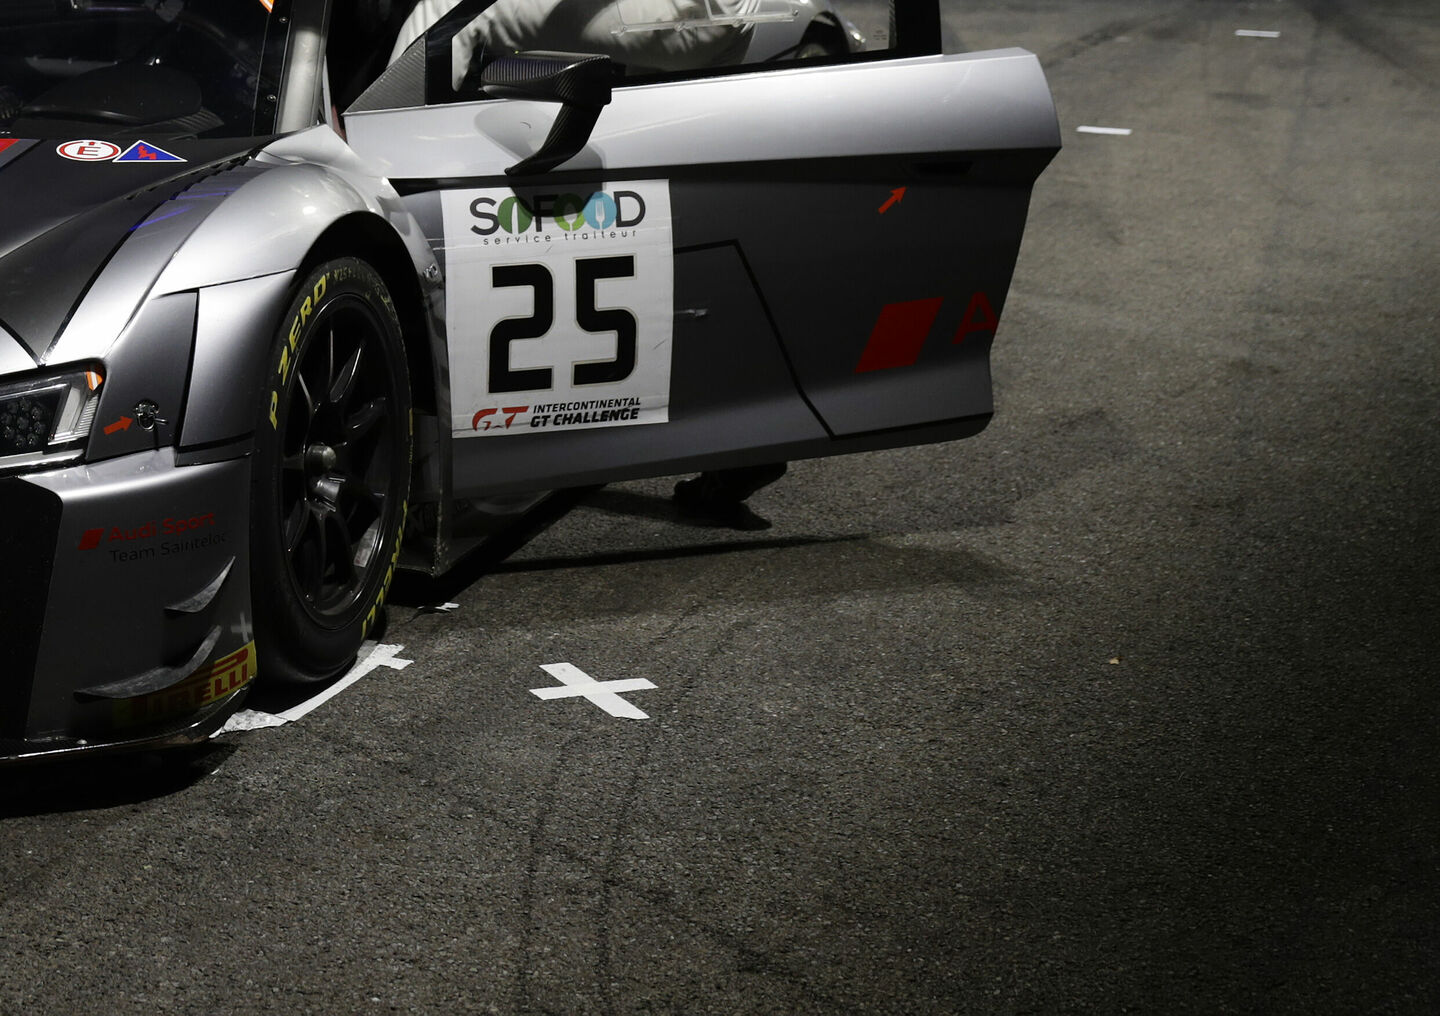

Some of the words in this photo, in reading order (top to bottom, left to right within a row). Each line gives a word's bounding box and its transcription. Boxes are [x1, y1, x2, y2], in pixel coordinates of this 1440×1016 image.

[483, 234, 552, 245] service
[564, 229, 637, 241] traiteur
[488, 255, 637, 394] 25
[533, 397, 641, 414] INTERCONTINENTAL
[530, 415, 550, 428] GT
[553, 408, 640, 425] CHALLENGE
[108, 521, 156, 542] Audi
[162, 512, 216, 536] Sport
[110, 547, 155, 563] Team
